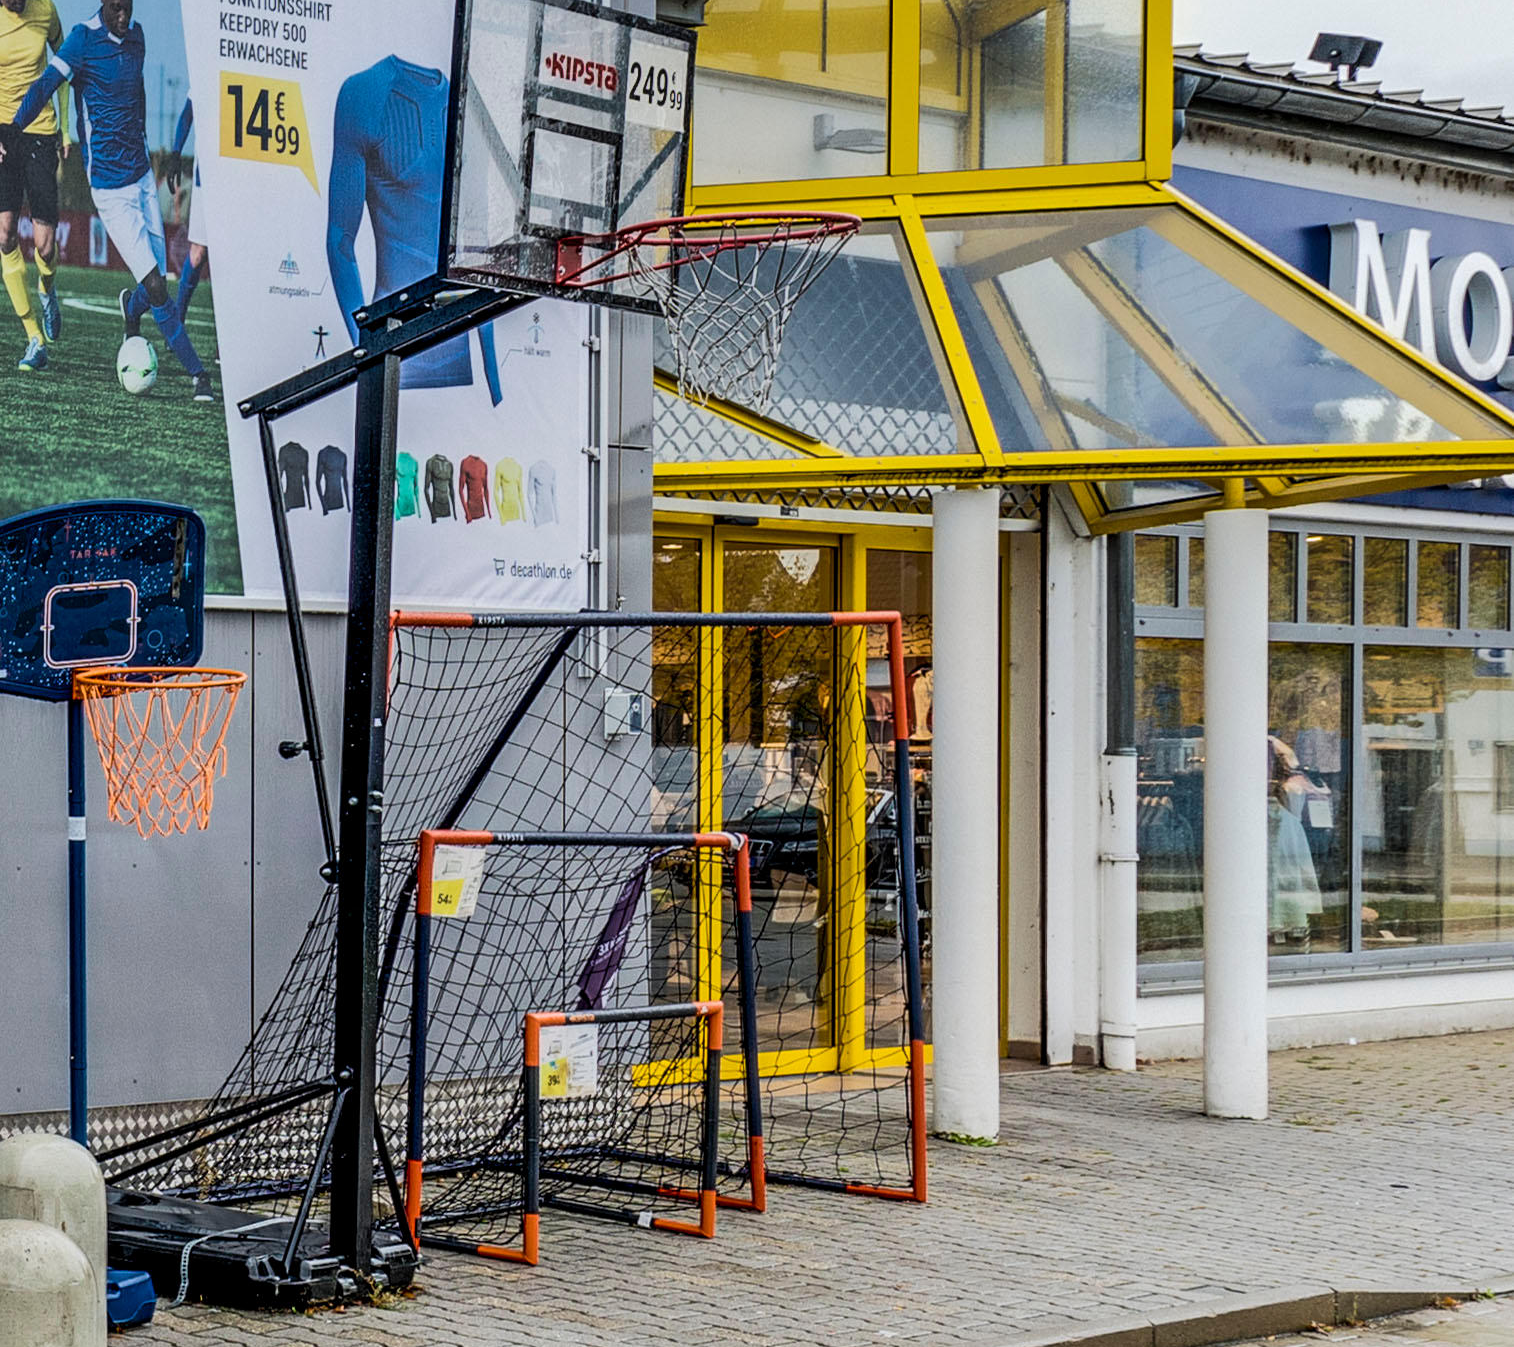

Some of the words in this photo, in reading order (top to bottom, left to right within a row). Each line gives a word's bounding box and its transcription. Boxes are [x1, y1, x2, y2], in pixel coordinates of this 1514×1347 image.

[220, 12, 279, 39] KEEPDRY
[283, 23, 306, 43] 500
[220, 38, 308, 70] ERWACHSENE
[629, 62, 668, 107] 249
[669, 90, 682, 111] 99
[228, 85, 273, 151] 14
[275, 125, 300, 155] 99
[1354, 218, 1514, 381] MO
[510, 560, 573, 579] decathlon.de
